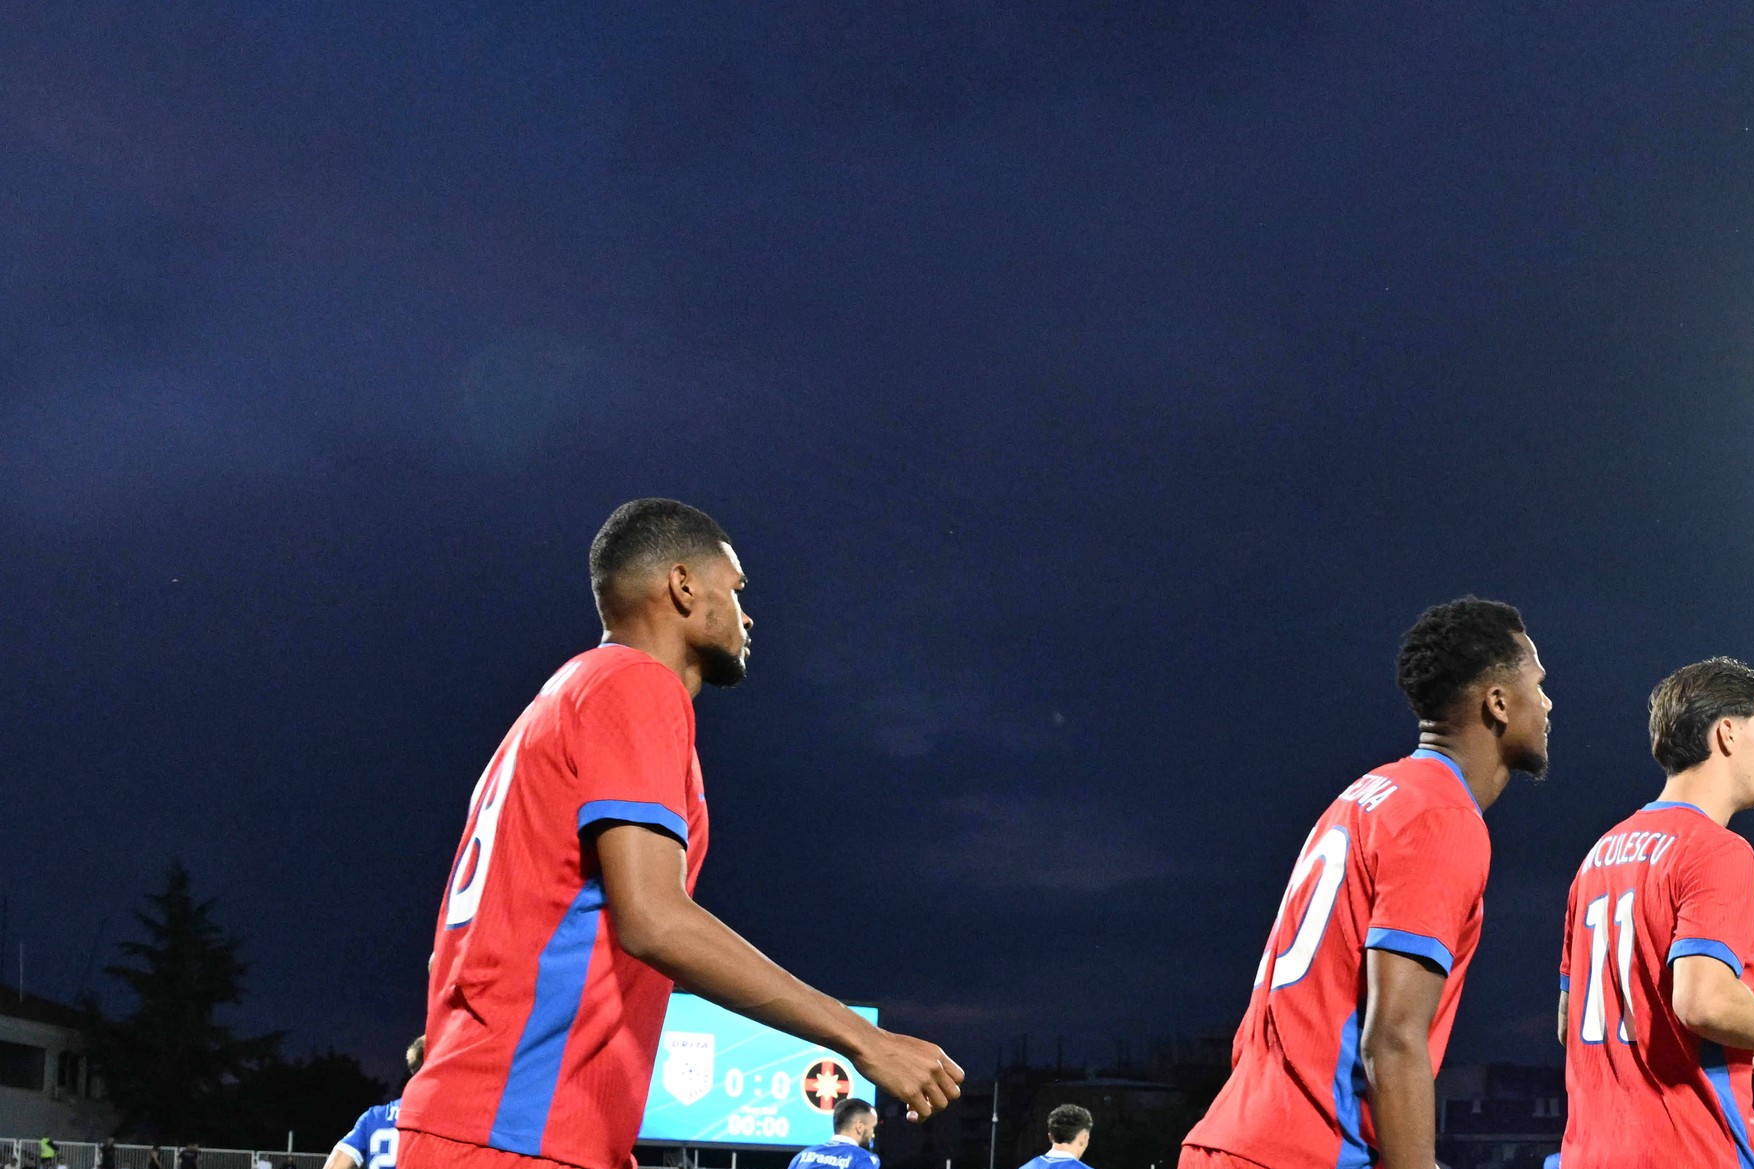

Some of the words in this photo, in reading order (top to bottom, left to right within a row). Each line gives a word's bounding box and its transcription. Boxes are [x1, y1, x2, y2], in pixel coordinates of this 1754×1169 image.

[1581, 888, 1639, 1045] 11
[725, 1068, 744, 1098] 0
[771, 1071, 790, 1100] 0
[727, 1114, 789, 1138] 00:00
